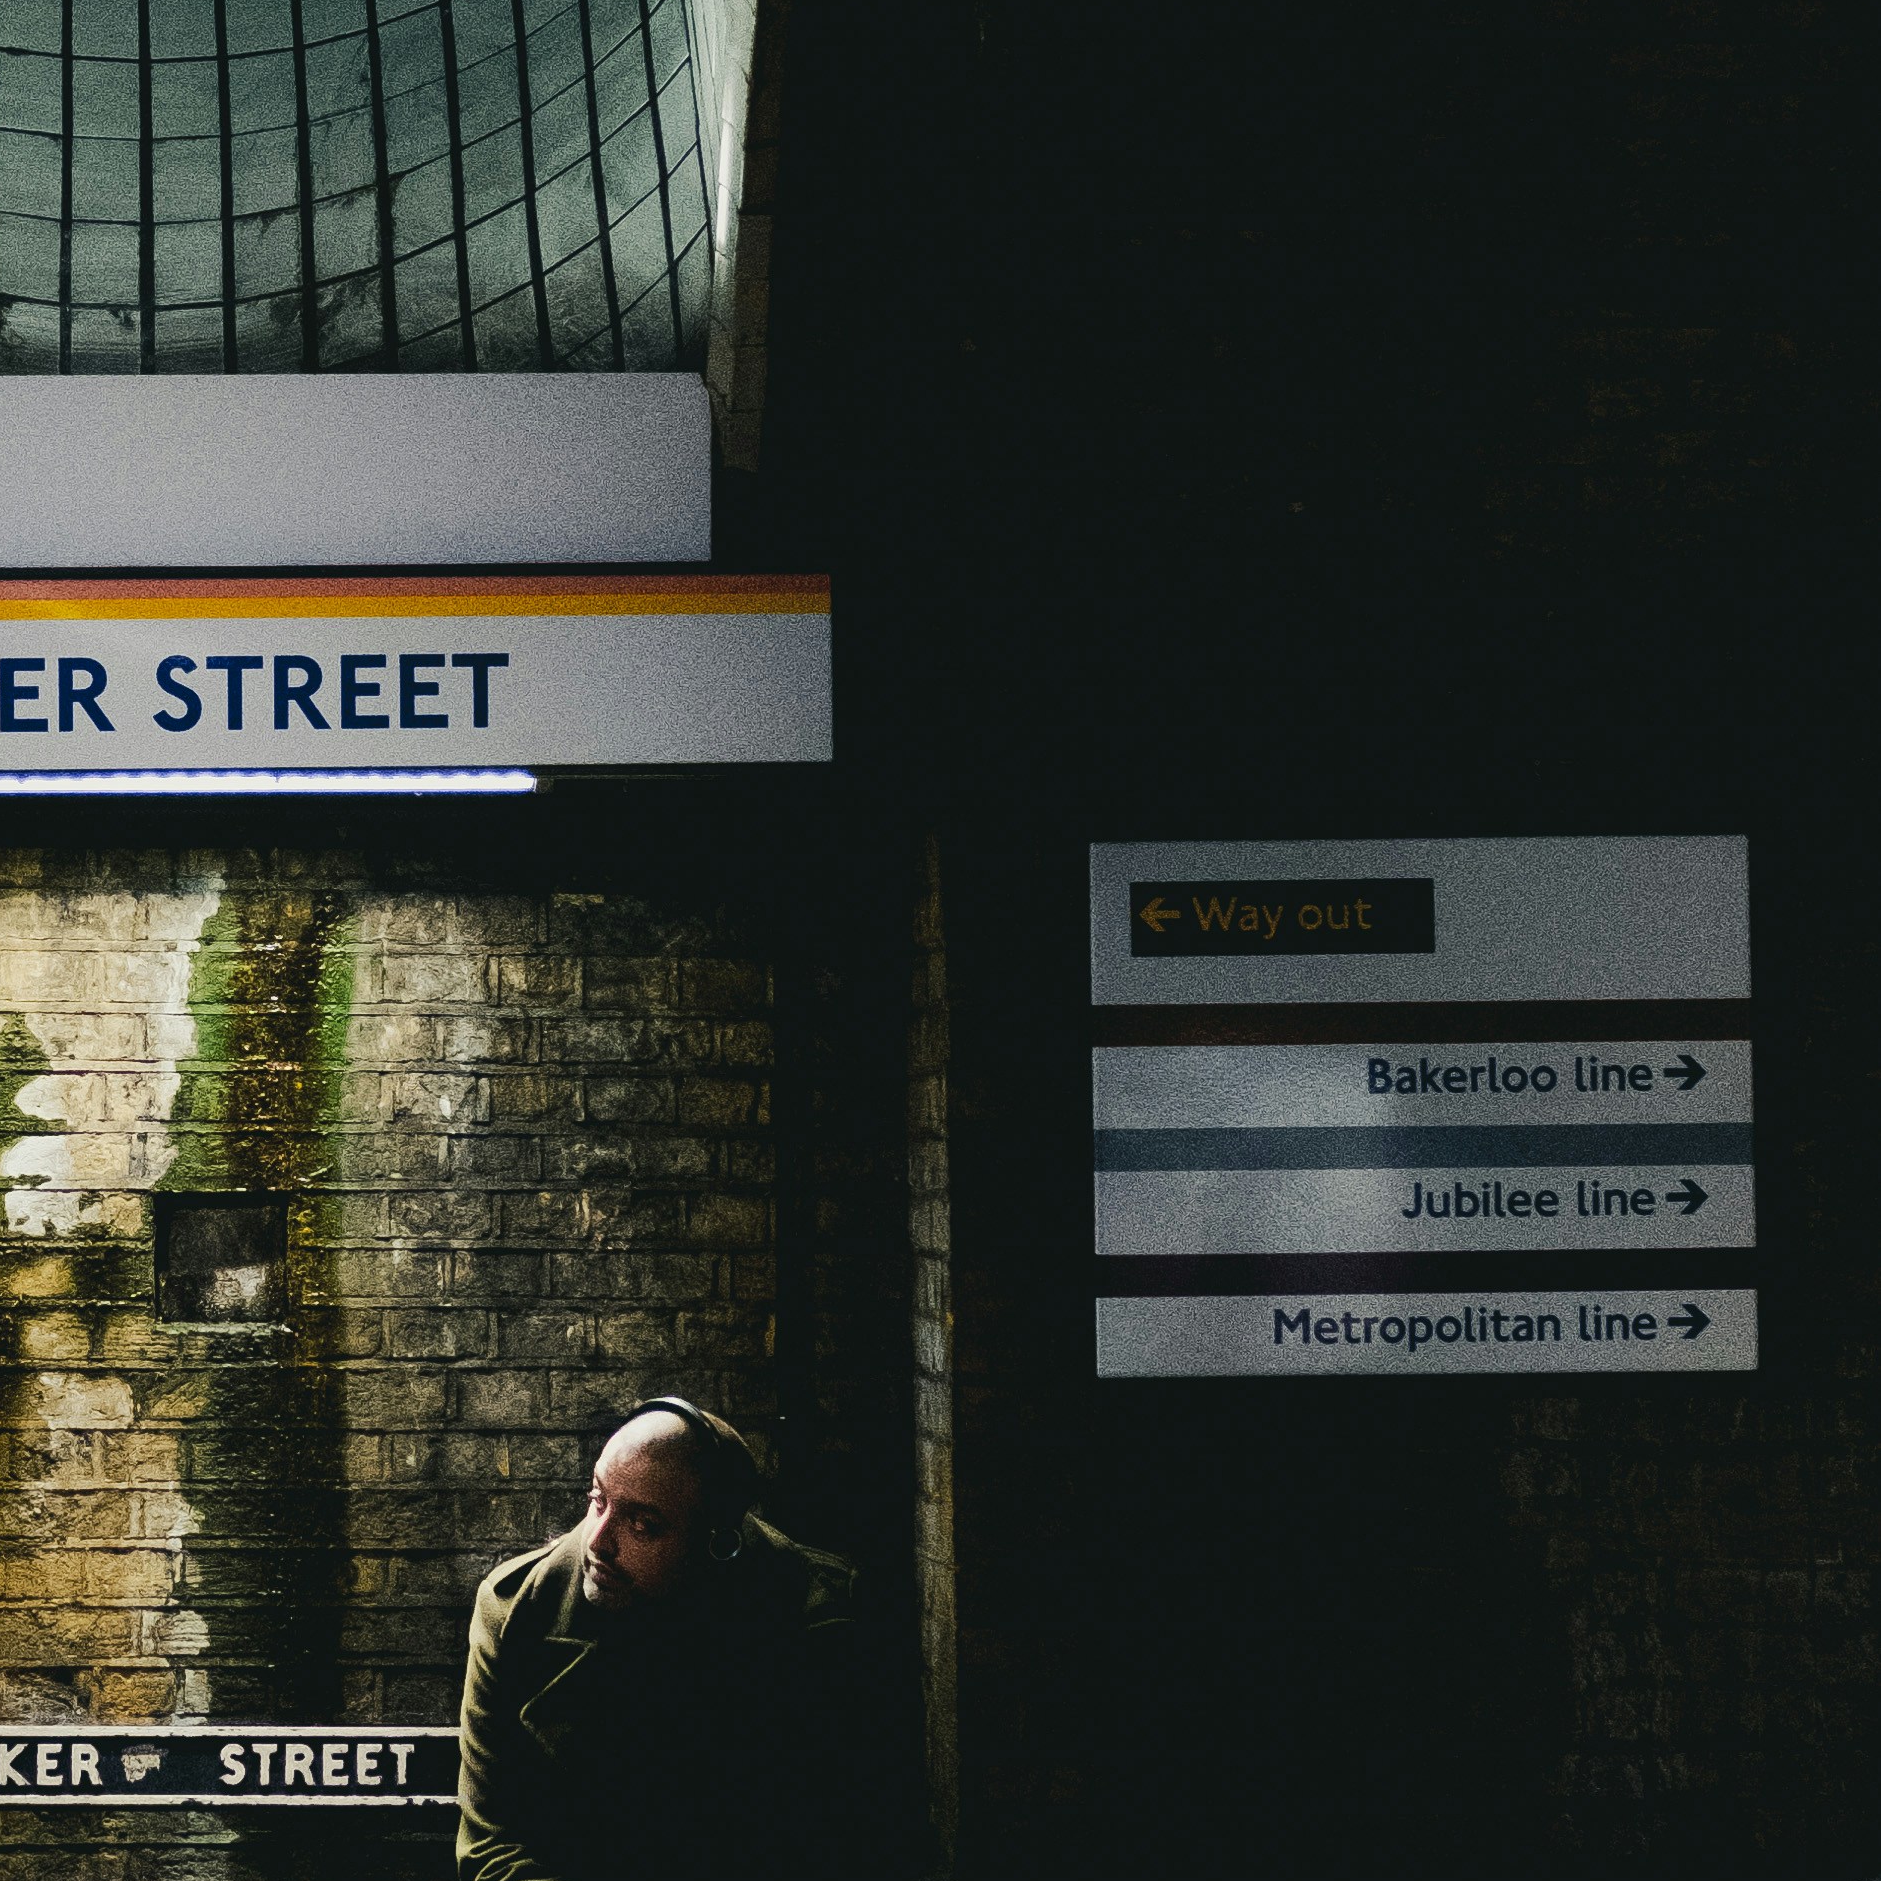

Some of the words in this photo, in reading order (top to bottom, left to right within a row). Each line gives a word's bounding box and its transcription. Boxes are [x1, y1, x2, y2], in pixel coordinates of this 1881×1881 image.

[154, 653, 510, 732] STREET
[1192, 896, 1284, 940] Way
[1298, 898, 1373, 931] out
[1367, 1055, 1559, 1096] Bakerloo
[1575, 1055, 1654, 1093] line
[1402, 1180, 1560, 1220] Jubilee
[1576, 1180, 1656, 1218] line
[1272, 1305, 1562, 1354] Metropolitan
[1578, 1304, 1658, 1342] line
[219, 1743, 416, 1786] STREET
